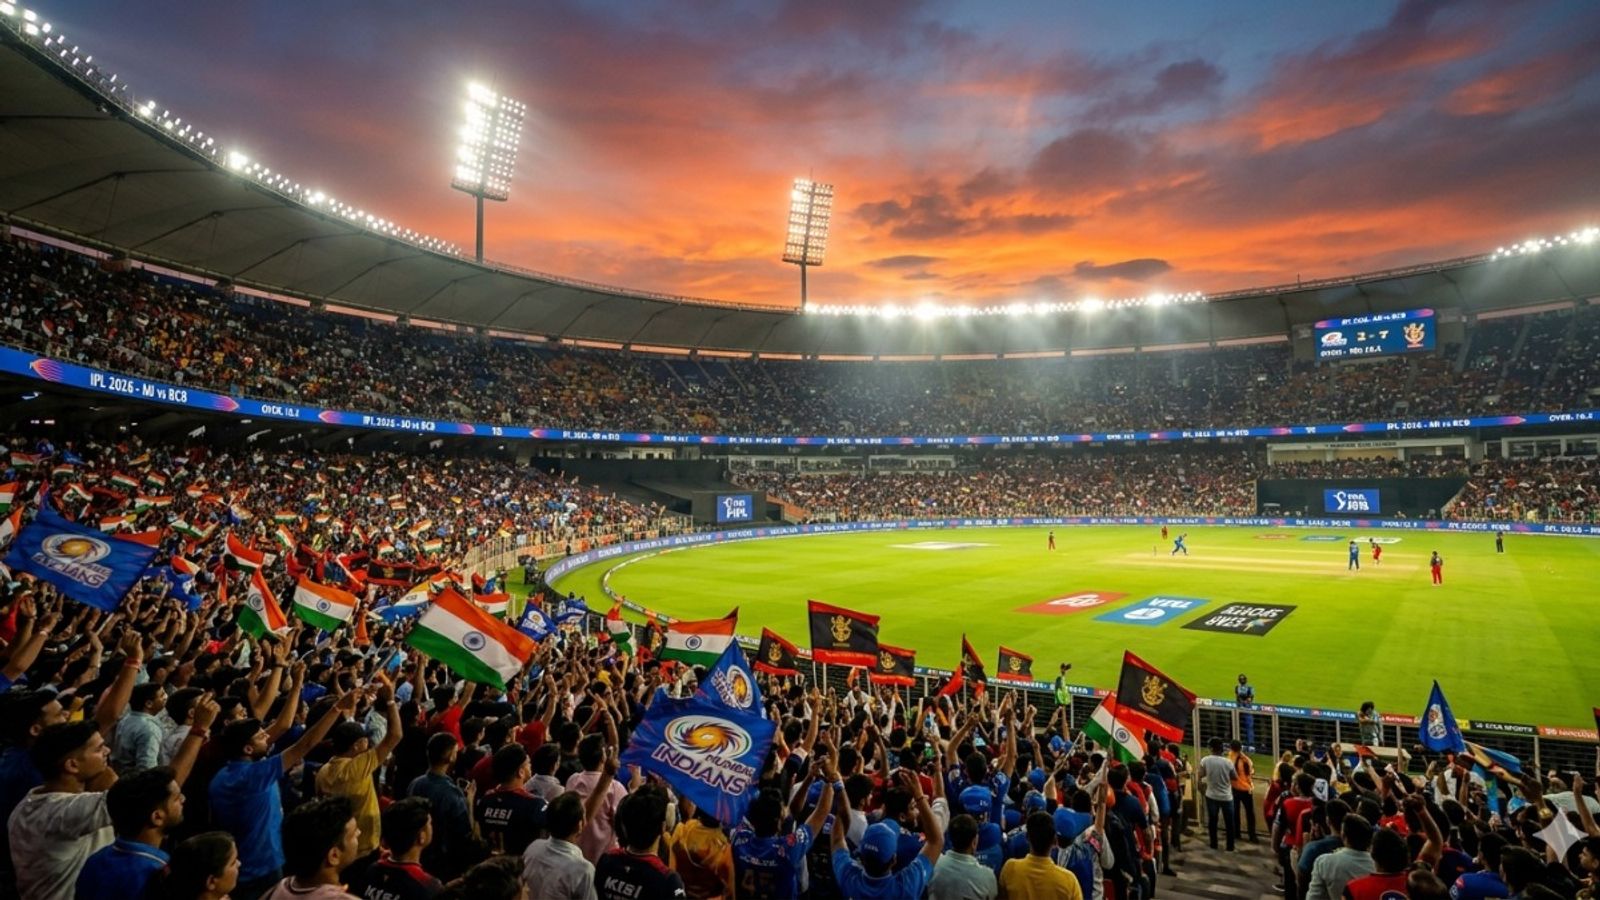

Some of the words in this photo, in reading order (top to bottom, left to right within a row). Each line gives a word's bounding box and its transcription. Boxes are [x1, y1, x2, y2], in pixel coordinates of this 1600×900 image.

[90, 372, 106, 389] IPL
[108, 377, 134, 394] 2026
[652, 742, 747, 794] INDIANS
